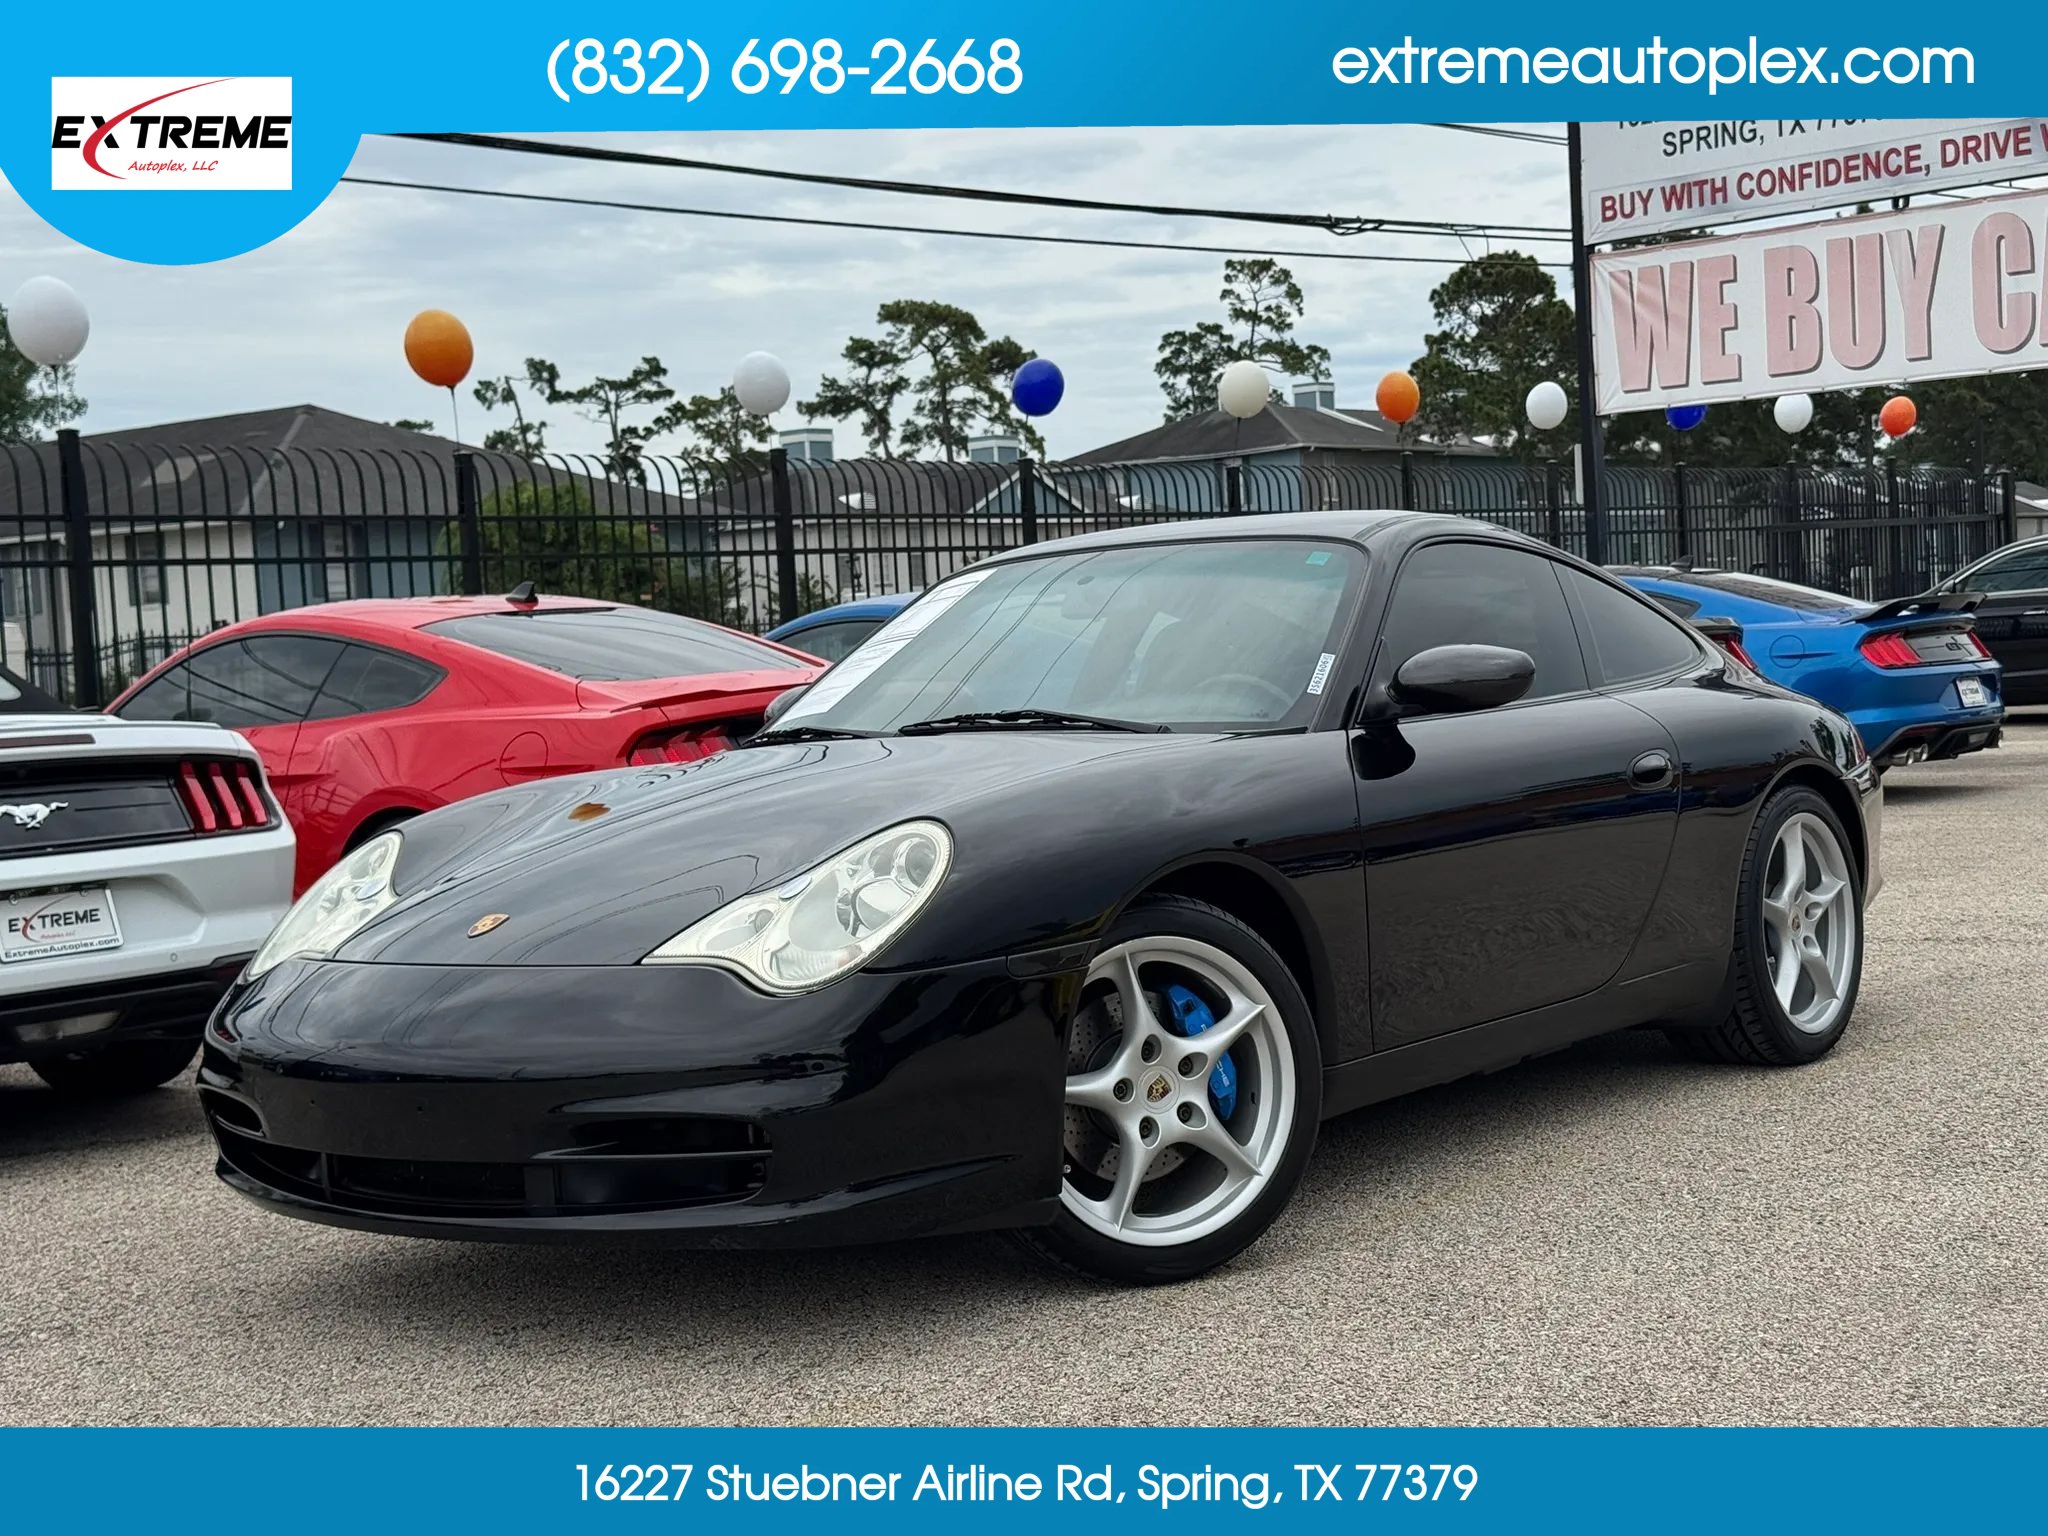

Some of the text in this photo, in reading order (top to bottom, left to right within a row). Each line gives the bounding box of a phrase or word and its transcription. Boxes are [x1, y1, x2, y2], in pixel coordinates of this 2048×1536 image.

[1662, 120, 1764, 157] SPRING,
[1600, 188, 1654, 222] BUY
[1660, 176, 1728, 212] WITH
[1736, 144, 1930, 200] CONFIDENCE,
[1940, 126, 2032, 168] DRIVE
[1609, 208, 2048, 392] WE BUY C
[8, 908, 101, 933] EXTREME
[4, 937, 120, 959] ExtremeAutoplex.com
